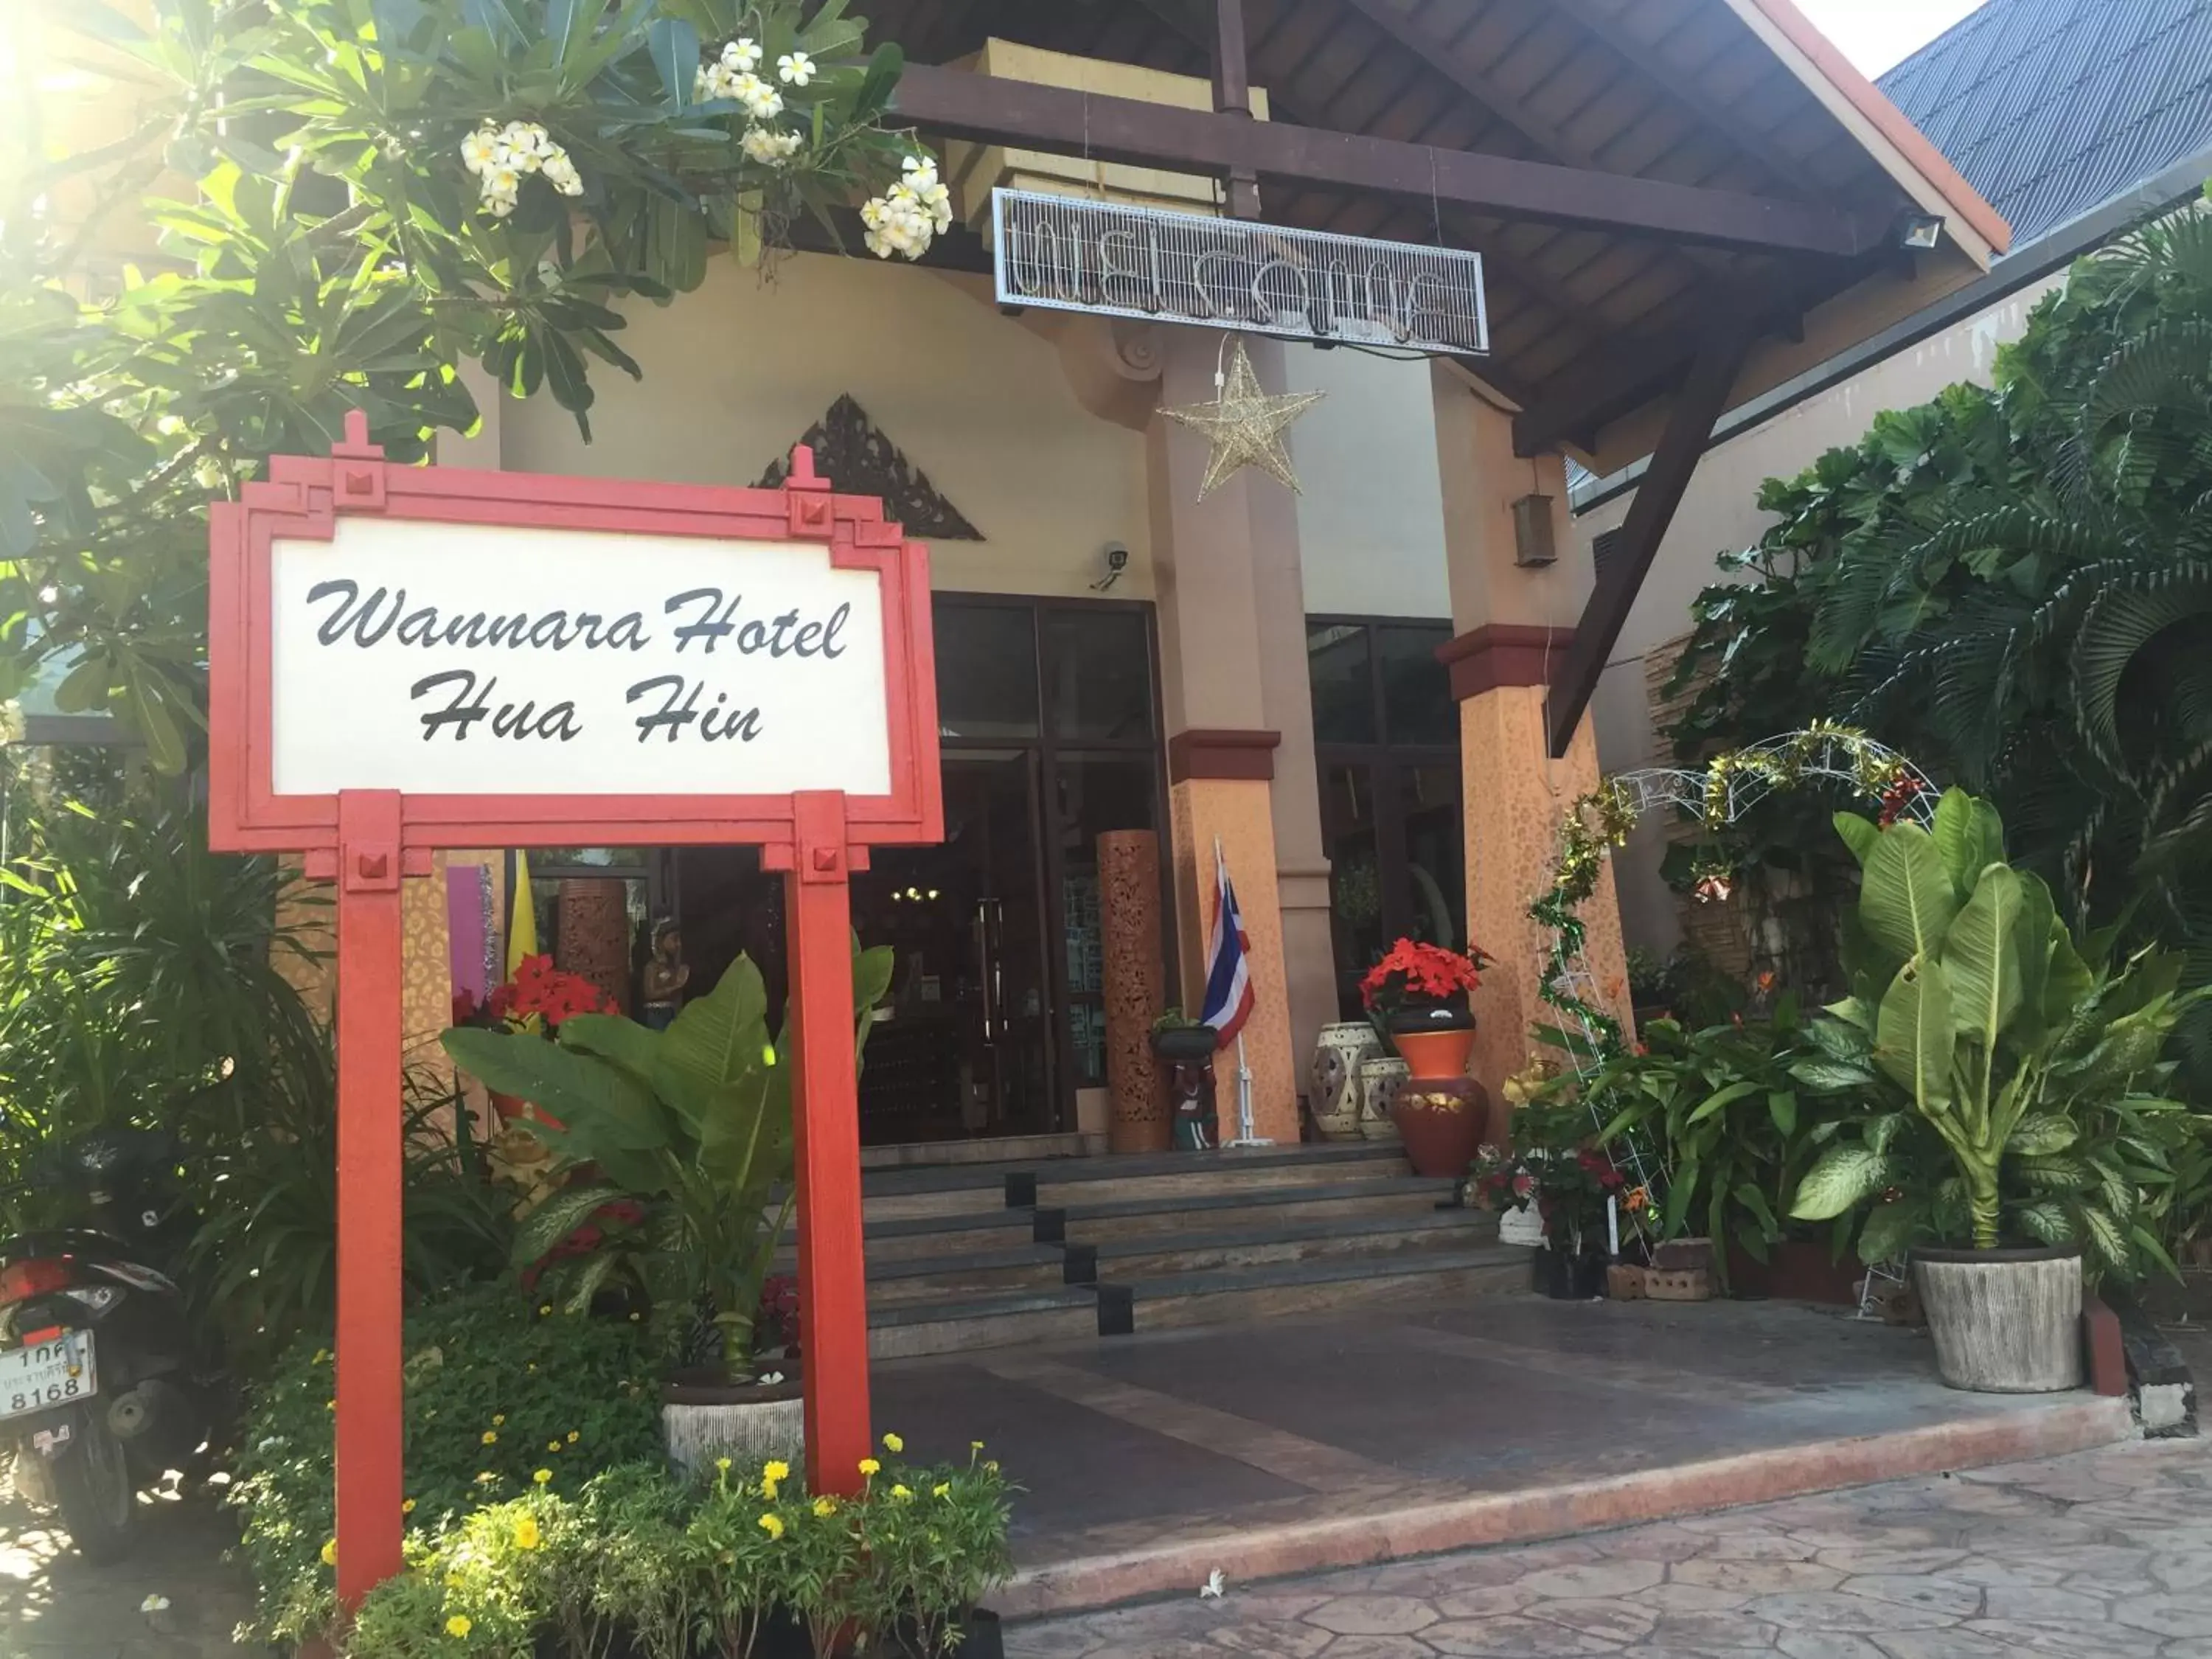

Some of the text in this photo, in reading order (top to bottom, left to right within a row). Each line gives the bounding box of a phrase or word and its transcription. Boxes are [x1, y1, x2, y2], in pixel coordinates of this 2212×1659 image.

[307, 579, 850, 659] Wannara Hotel
[411, 669, 762, 744] Hua Hin
[11, 1378, 79, 1410] 8168
